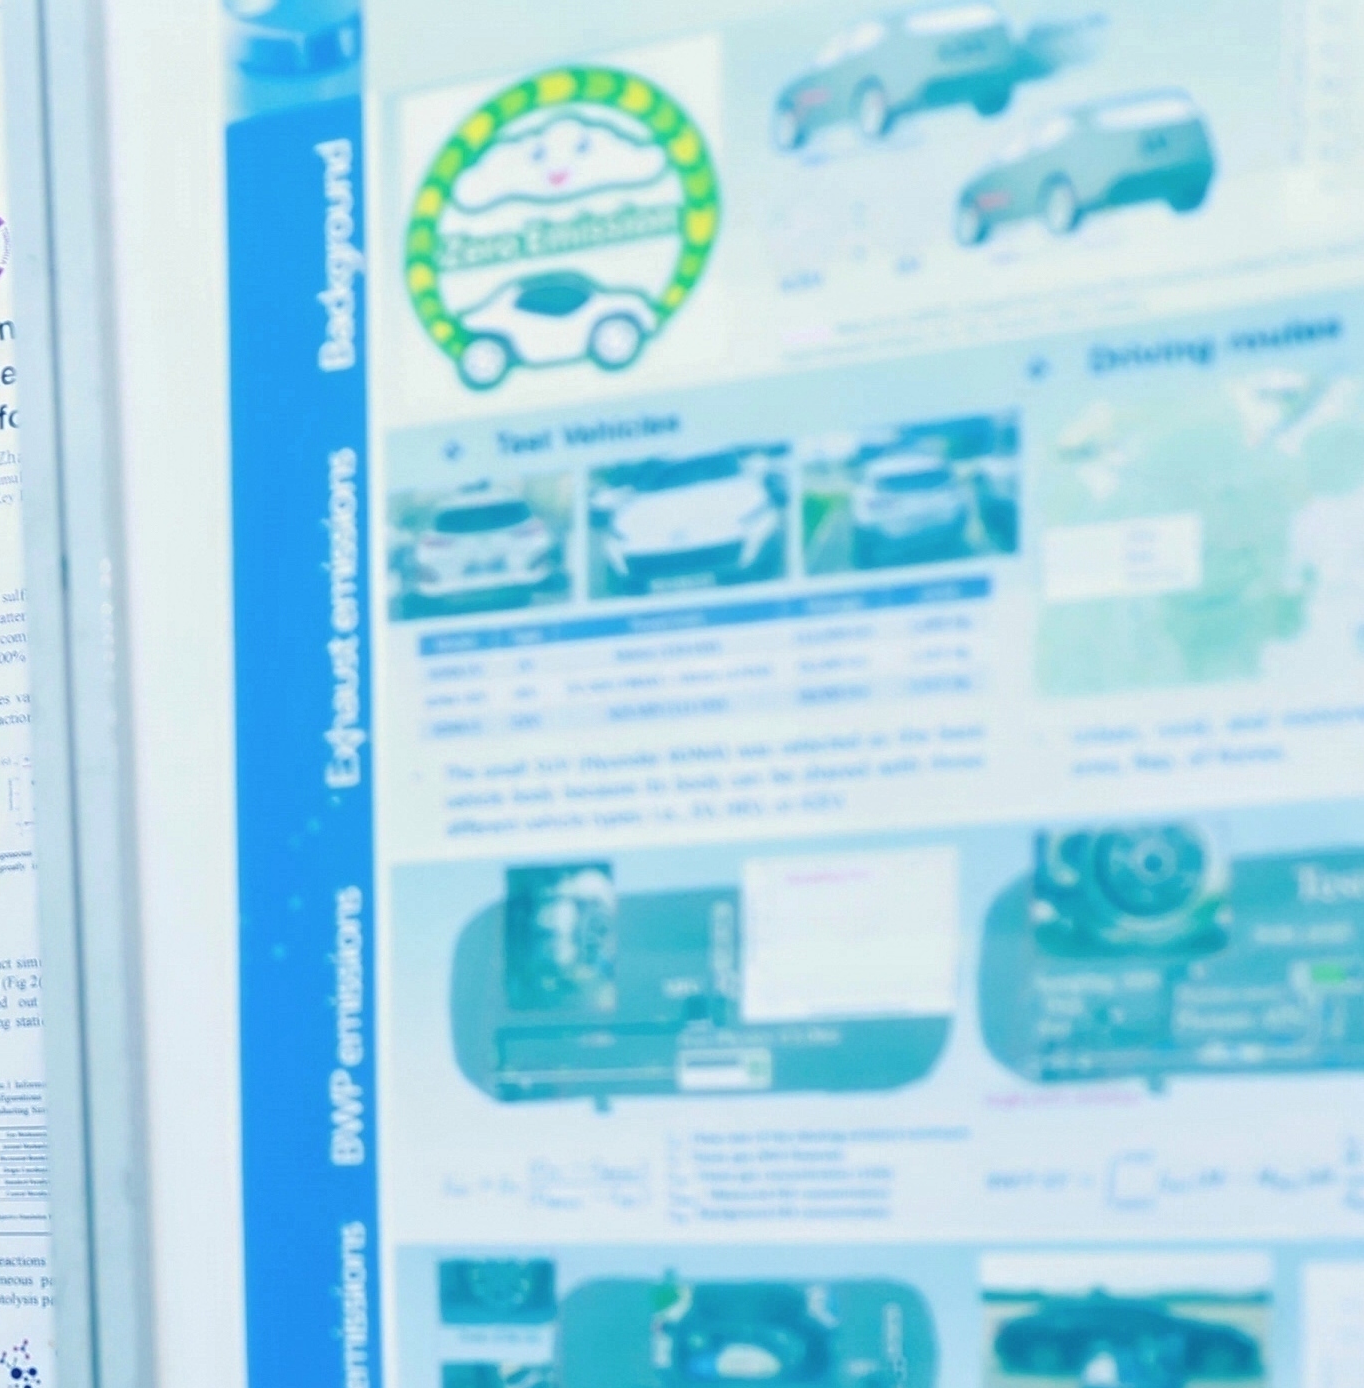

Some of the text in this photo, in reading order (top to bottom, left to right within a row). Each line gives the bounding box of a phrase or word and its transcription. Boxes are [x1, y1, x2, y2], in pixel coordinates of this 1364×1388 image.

[314, 138, 366, 371] Background
[496, 414, 680, 455] Test Vehicles
[320, 447, 367, 789] Exhaust emissions
[325, 886, 365, 1166] BWP emissions
